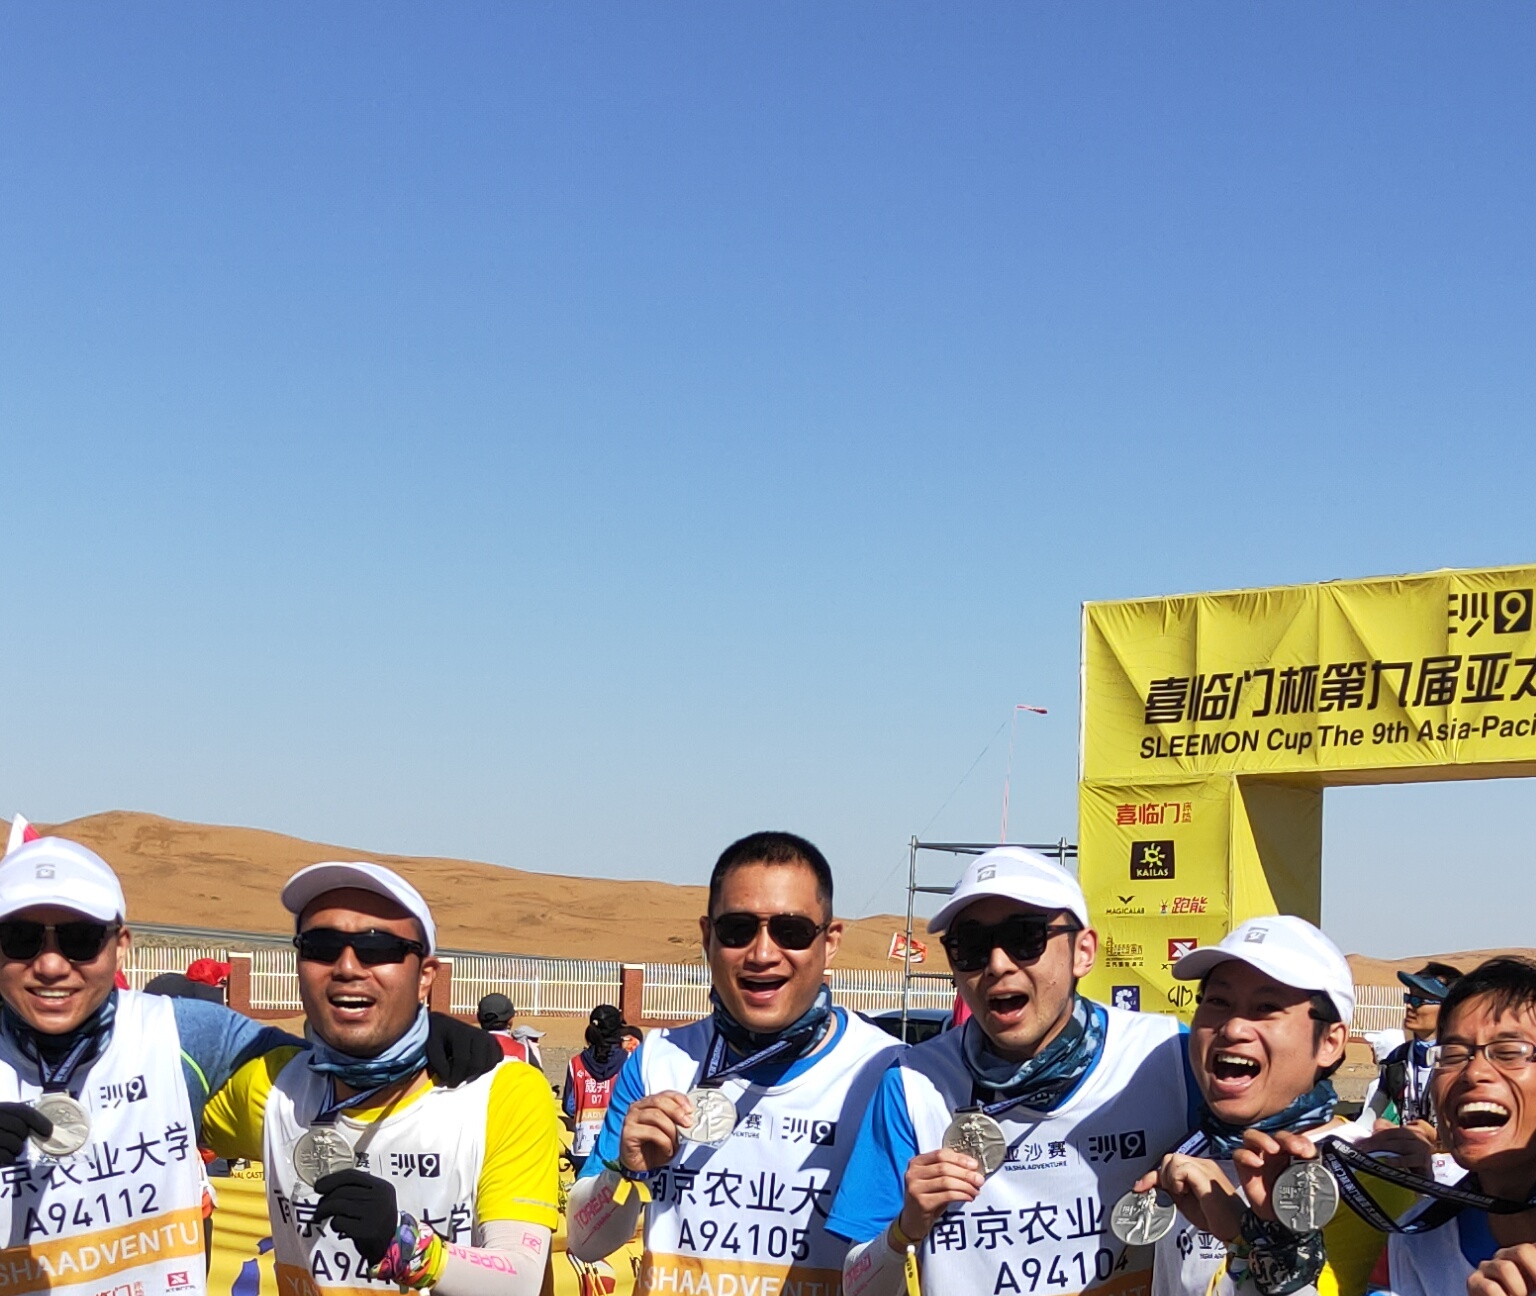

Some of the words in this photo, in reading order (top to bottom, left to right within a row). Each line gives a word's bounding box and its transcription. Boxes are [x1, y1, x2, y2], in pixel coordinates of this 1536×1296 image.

[1140, 730, 1259, 759] SLEEMON
[1271, 727, 1312, 755] Cup
[1317, 725, 1363, 748] The
[1371, 725, 1409, 745] 9th
[1116, 803, 1181, 825] 喜临门
[1136, 869, 1168, 877] KAILAS
[1172, 897, 1208, 914] 跑能
[592, 1095, 602, 1104] 07
[1004, 1141, 1067, 1162] 亚沙赛
[23, 1184, 159, 1239] A94112
[574, 1186, 614, 1230] TOREAD
[678, 1220, 810, 1261] A94105
[929, 1197, 1108, 1254] 南京农业
[993, 1247, 1128, 1296] A94104
